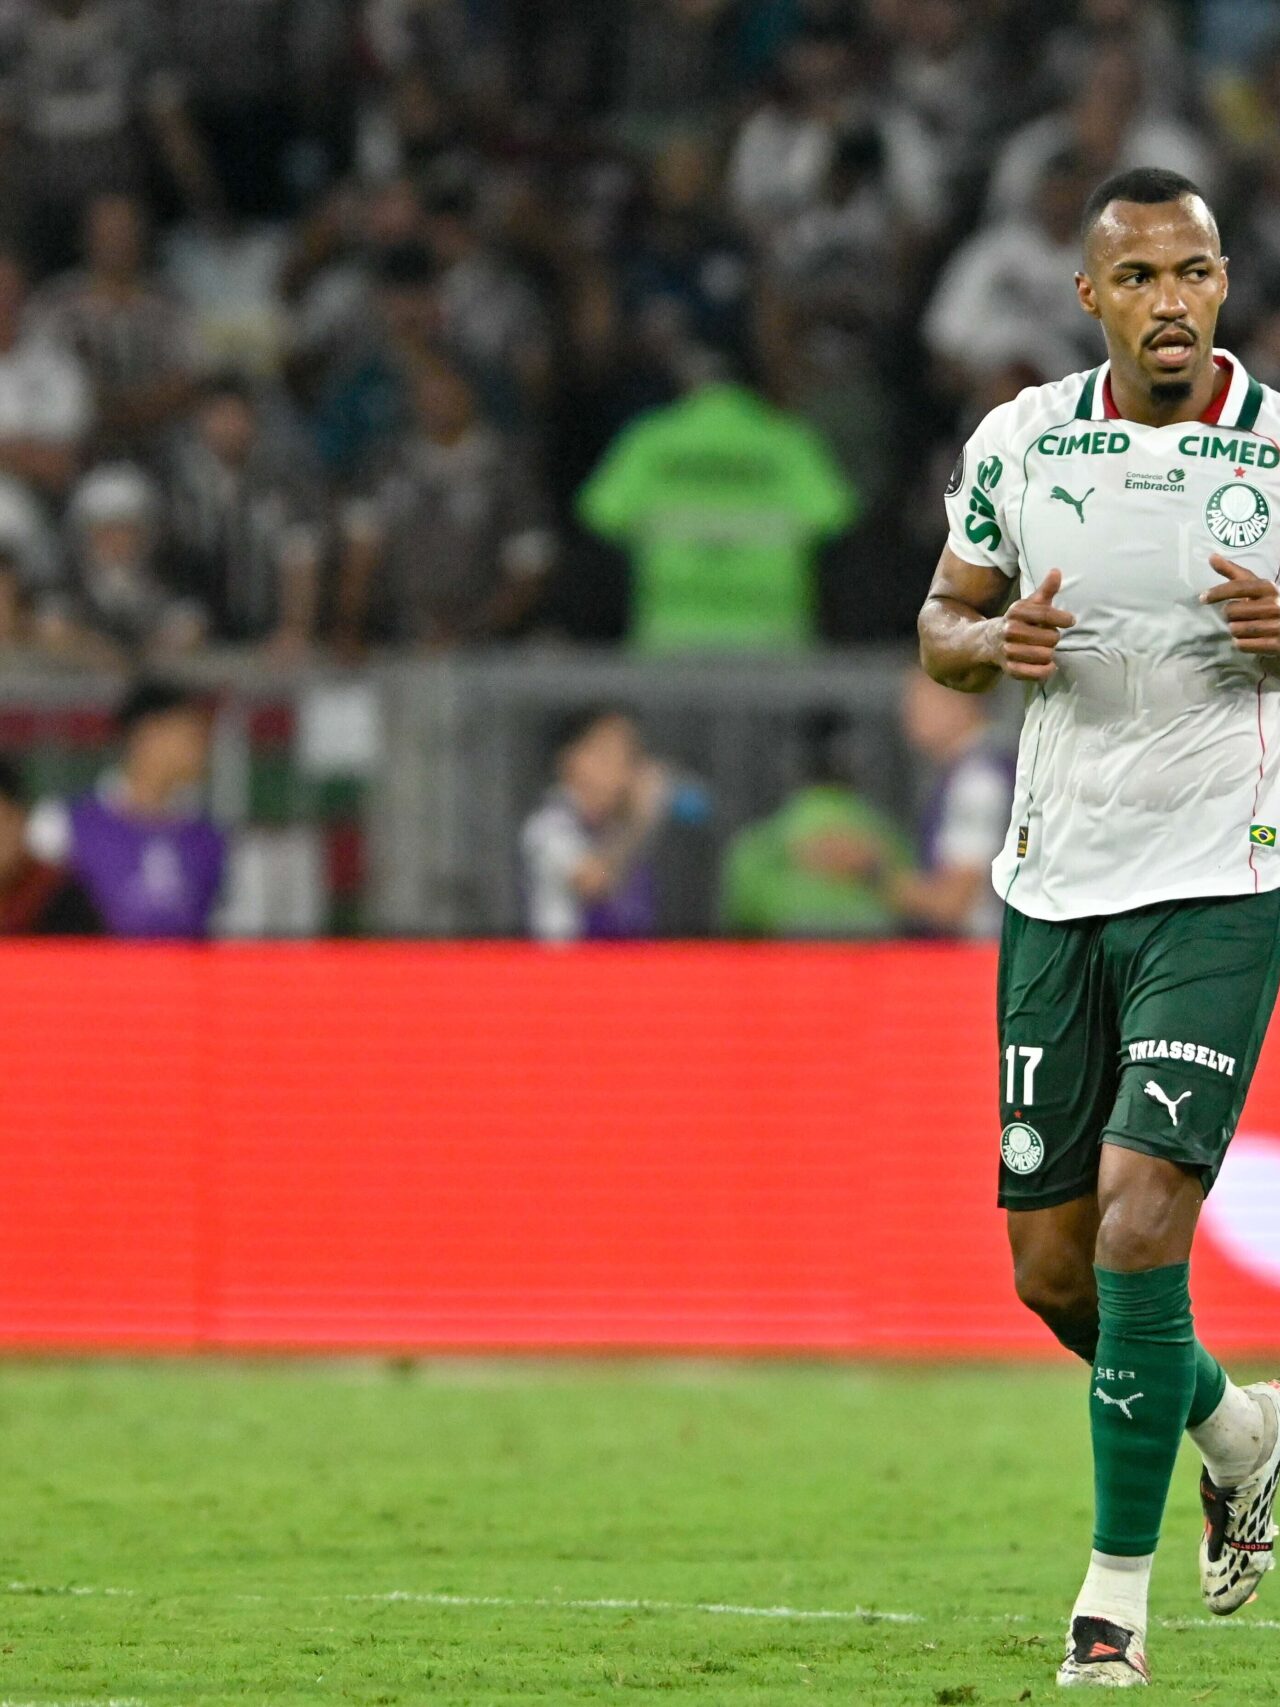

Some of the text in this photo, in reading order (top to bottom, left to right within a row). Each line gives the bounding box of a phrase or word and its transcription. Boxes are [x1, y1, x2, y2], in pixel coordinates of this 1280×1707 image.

[1037, 431, 1131, 456] CIMED
[1178, 435, 1280, 469] CIMED
[1124, 479, 1185, 492] Embracon
[1206, 508, 1269, 547] PALMEIRAS
[1128, 1039, 1236, 1076] UNIASSELVI
[1005, 1045, 1044, 1106] 17
[1002, 1144, 1042, 1171] PALMEIRAS
